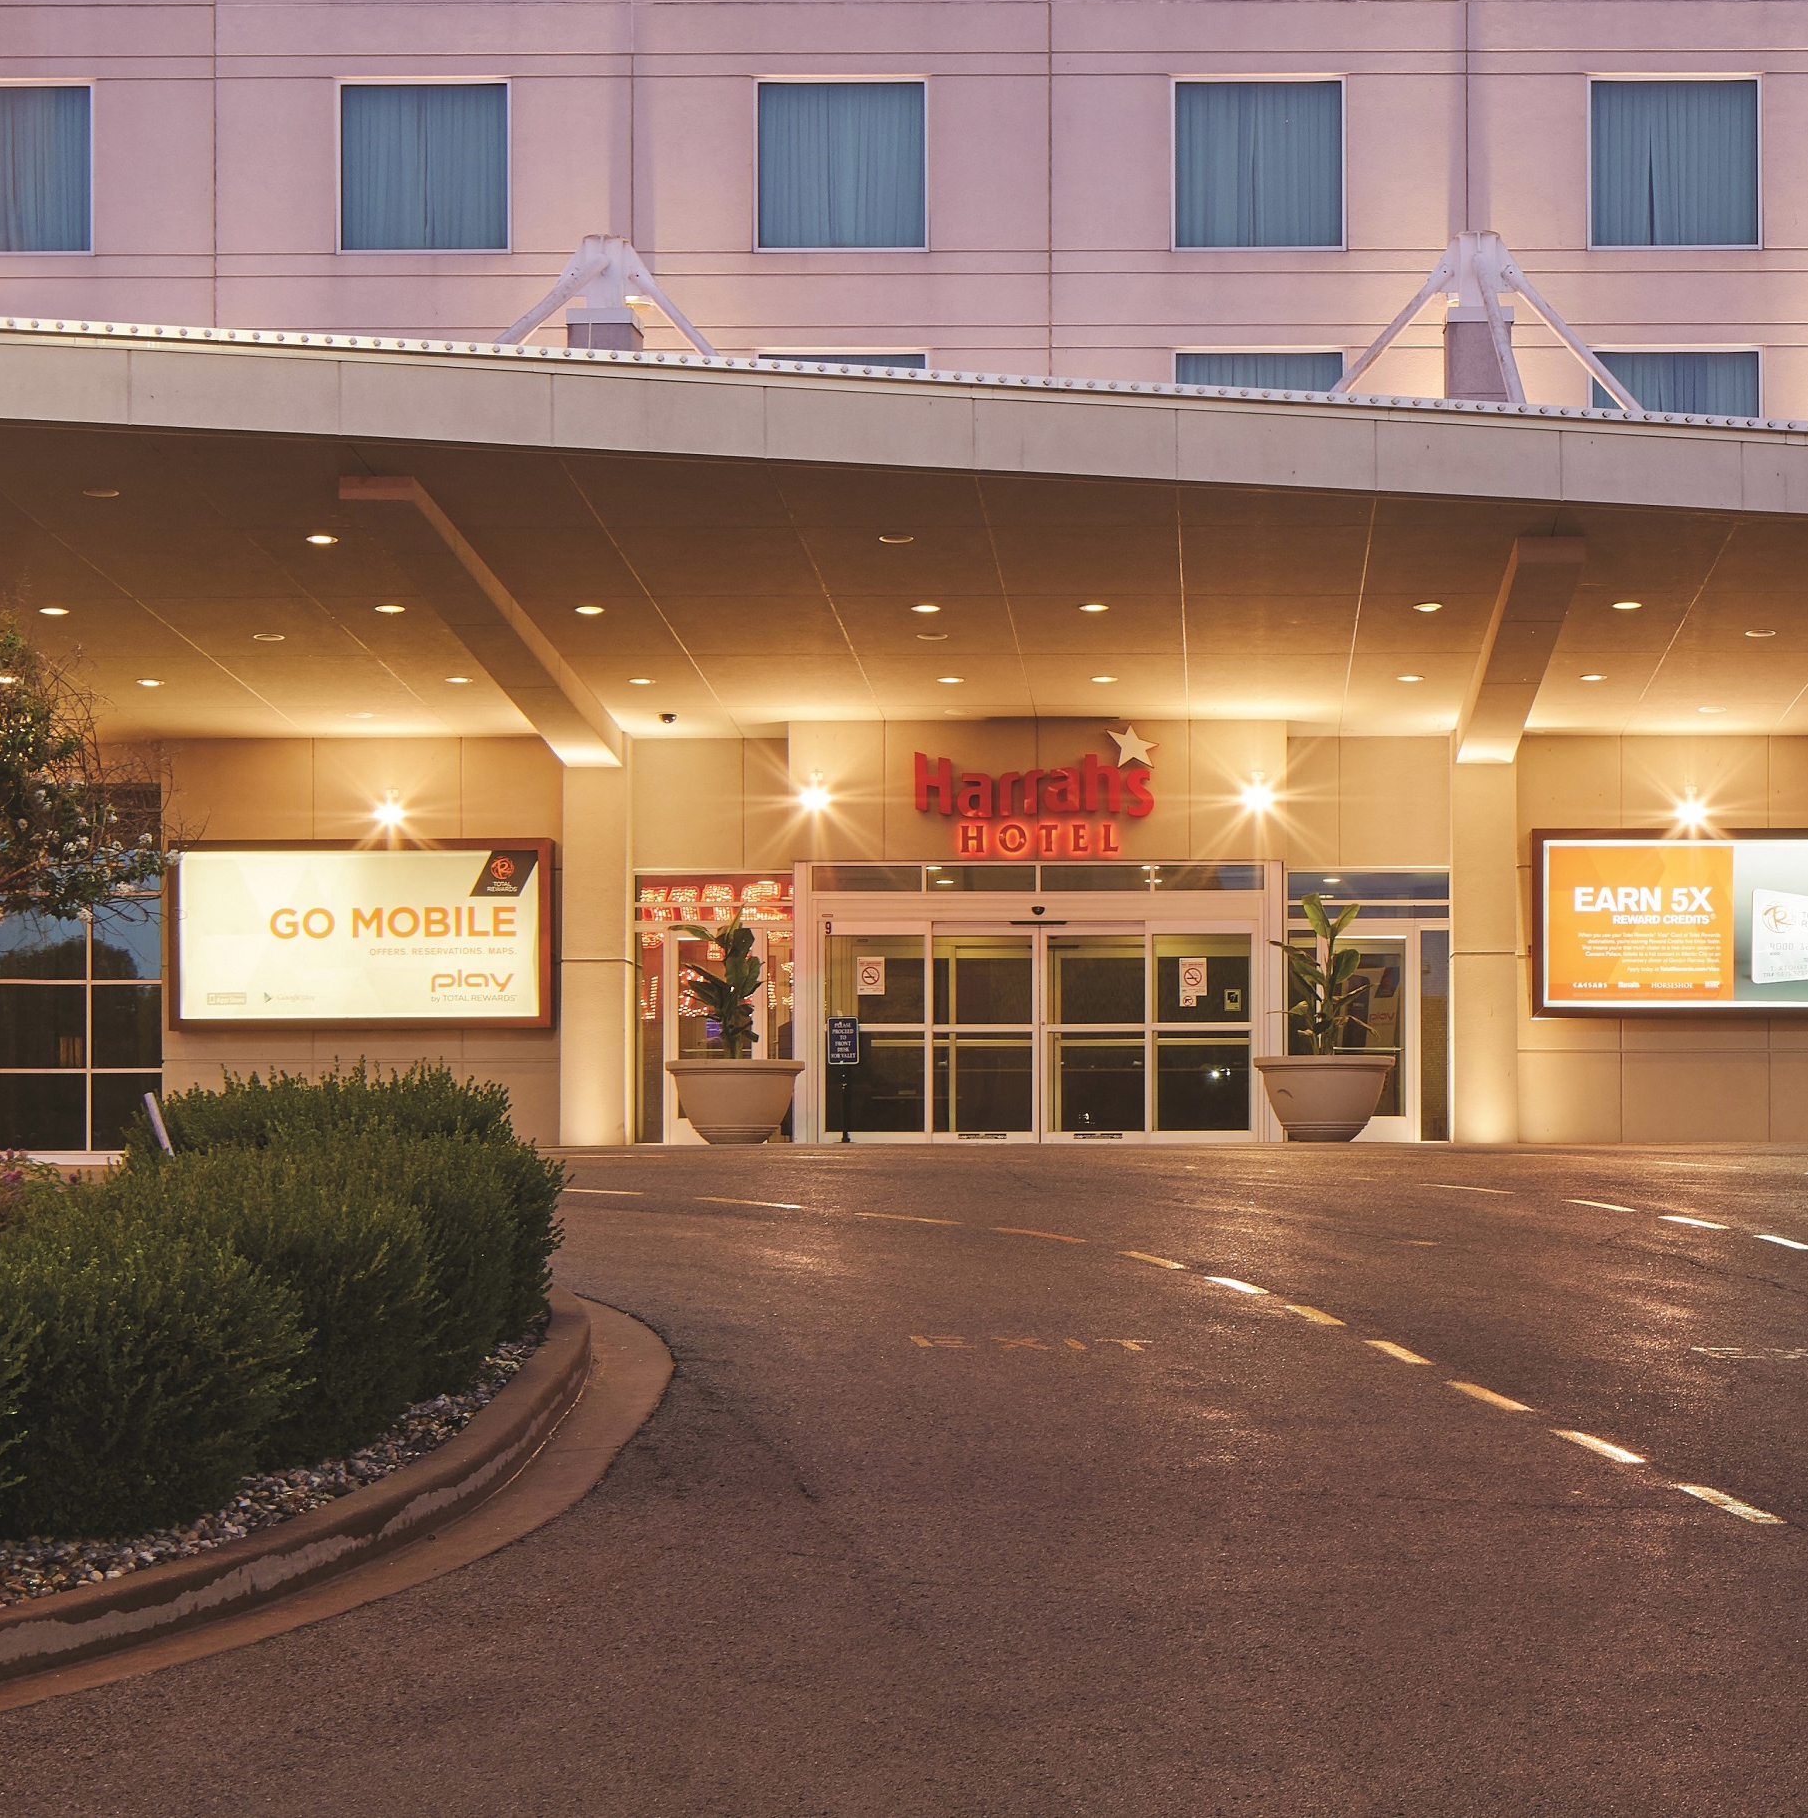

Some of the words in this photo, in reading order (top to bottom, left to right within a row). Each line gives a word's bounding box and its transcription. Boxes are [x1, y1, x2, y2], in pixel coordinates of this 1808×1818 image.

[960, 823, 1119, 853] HOTEL
[1573, 886, 1661, 912] EARN
[1671, 886, 1714, 912] 5X
[269, 907, 335, 939] GO
[351, 906, 517, 938] MOBILE
[1612, 914, 1661, 925] REWARD
[825, 921, 832, 935] 9
[369, 948, 409, 956] OFFERS.
[411, 947, 485, 955] RESERVATIONS.
[487, 947, 517, 955] MAPS.
[429, 969, 514, 993] play
[430, 995, 440, 1003] by
[471, 994, 516, 1002] REWARDS
[908, 1335, 1153, 1351] EXIT
